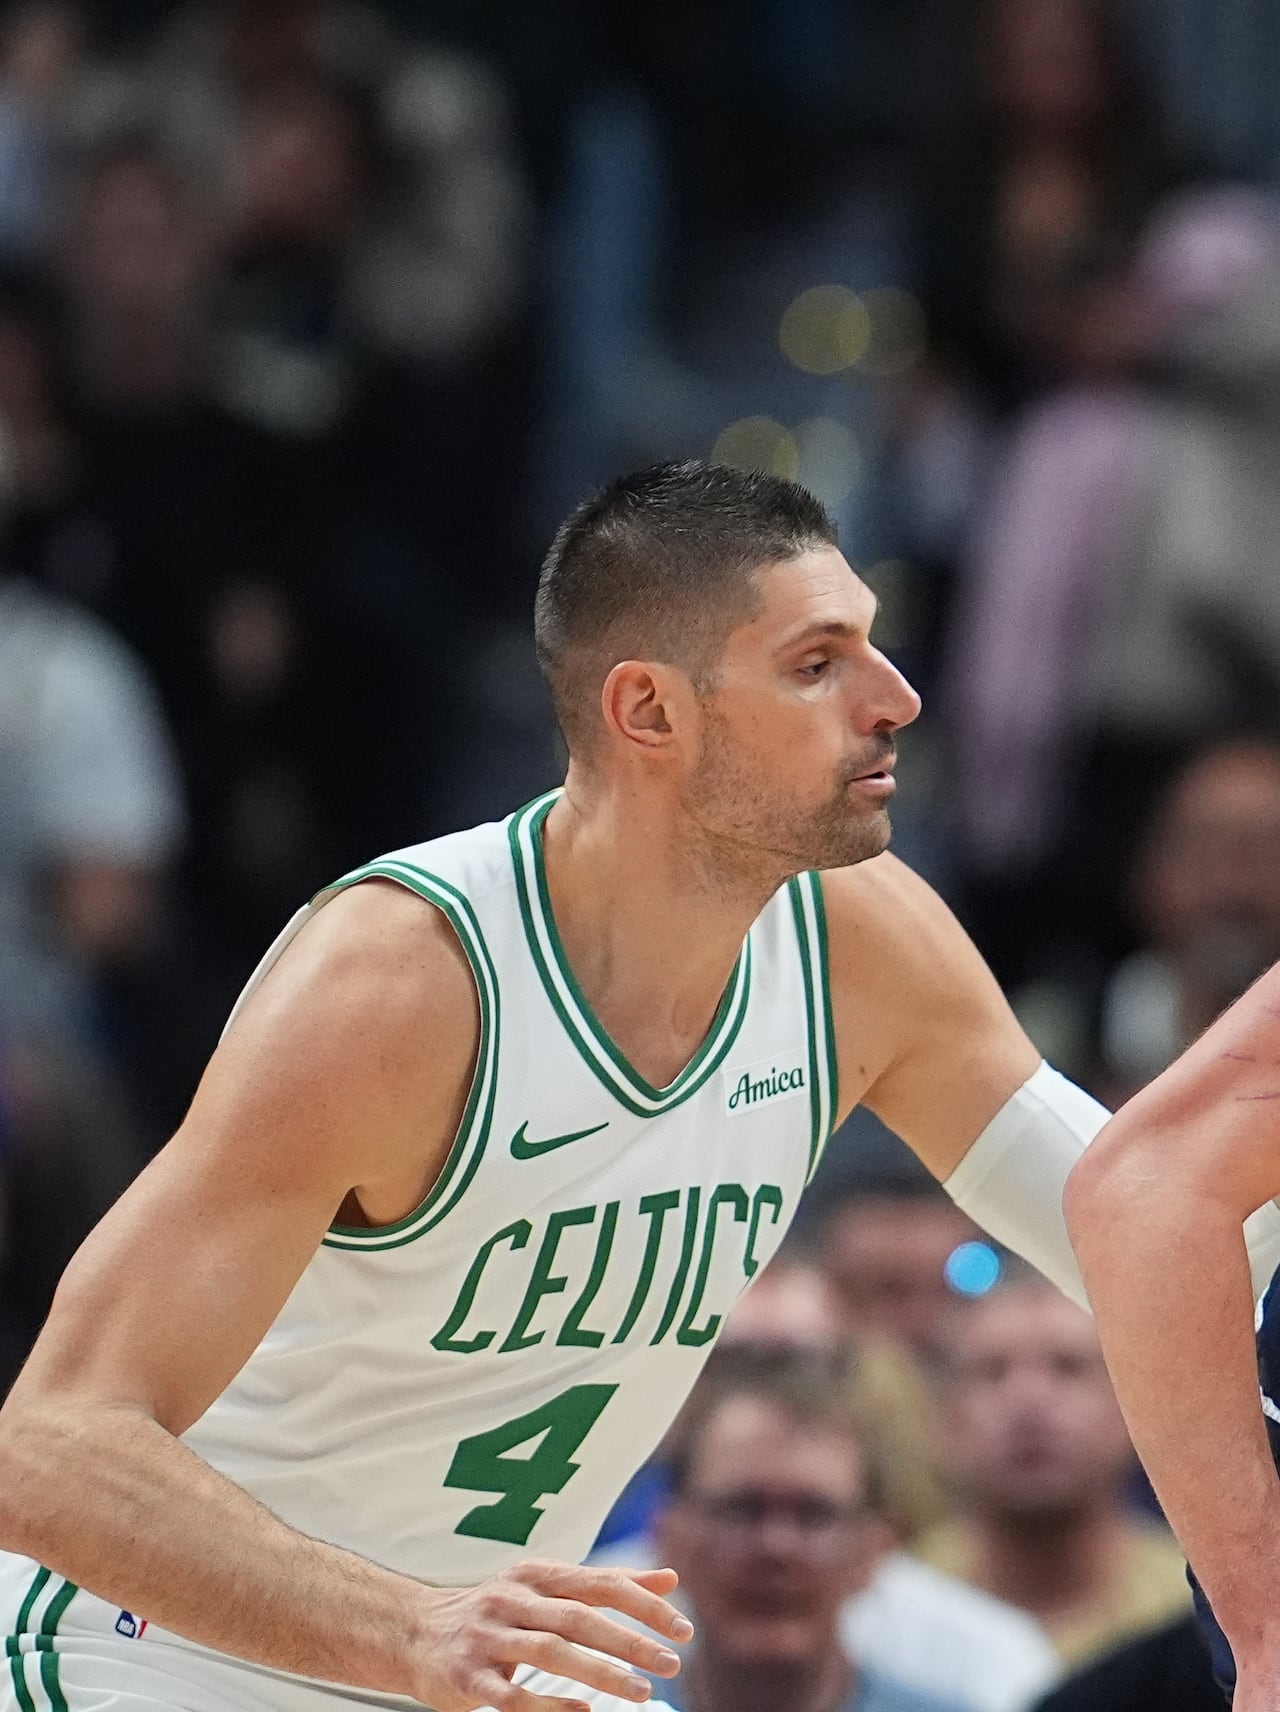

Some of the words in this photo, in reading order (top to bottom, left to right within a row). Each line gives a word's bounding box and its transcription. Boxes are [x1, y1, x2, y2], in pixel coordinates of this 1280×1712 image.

[728, 1066, 805, 1109] Amica
[430, 1184, 783, 1354] CELTICS
[443, 1383, 620, 1546] 4
